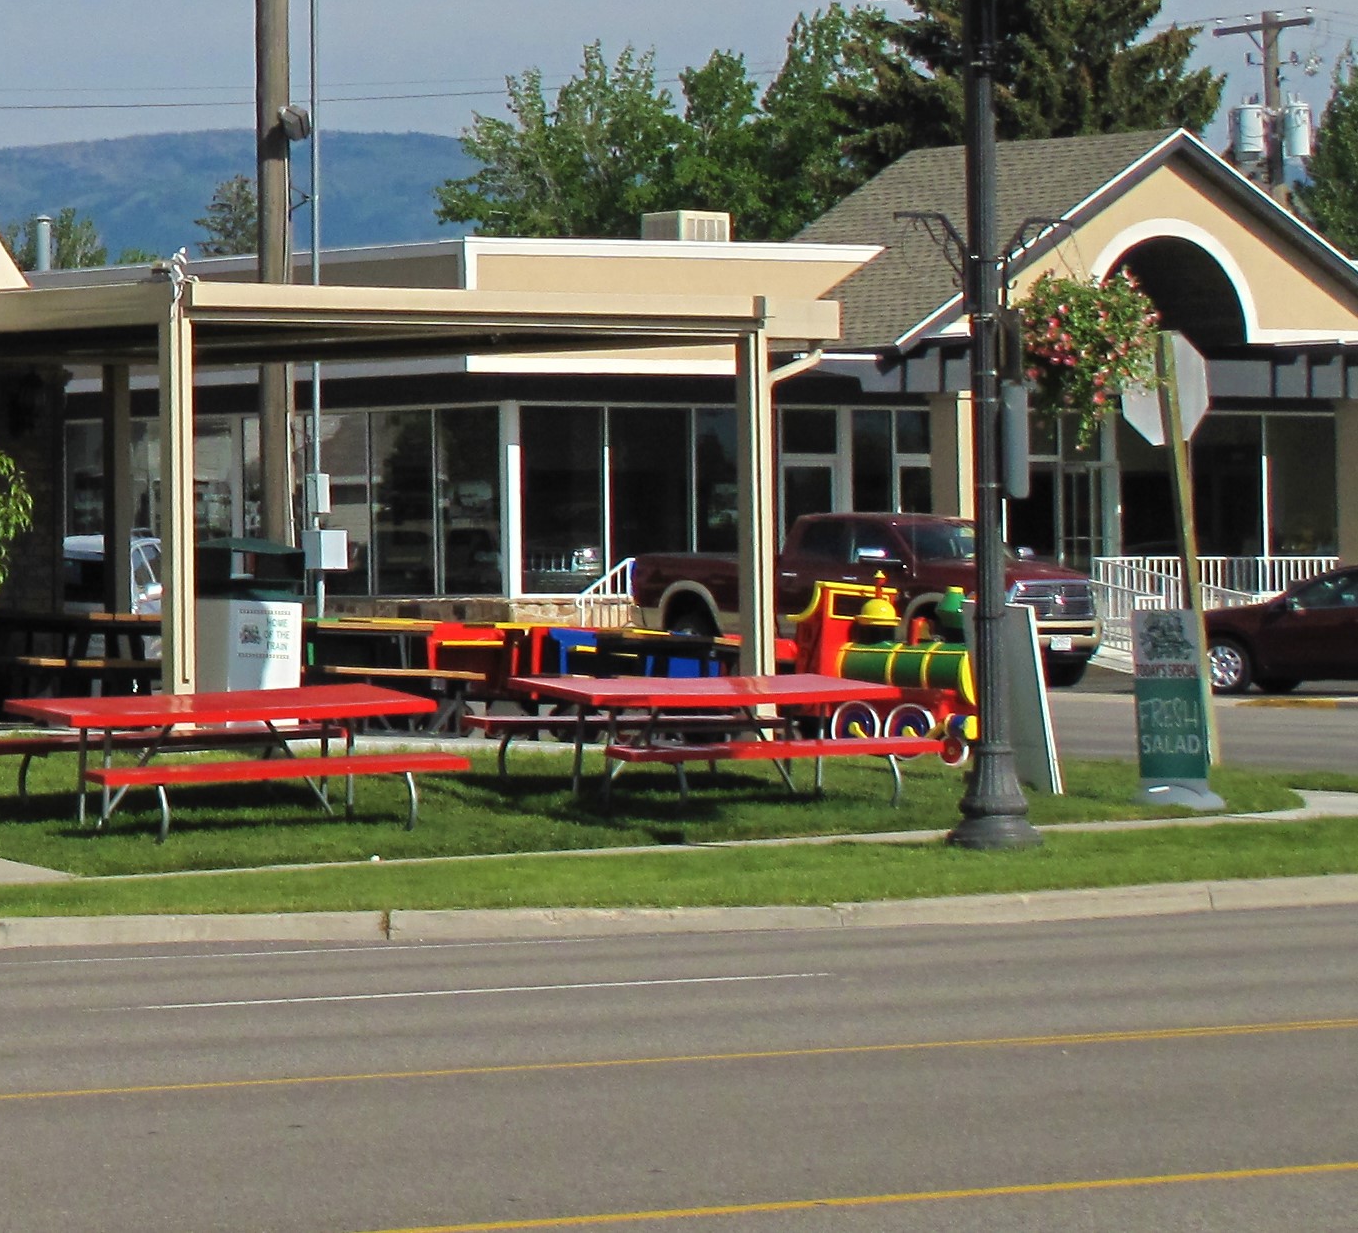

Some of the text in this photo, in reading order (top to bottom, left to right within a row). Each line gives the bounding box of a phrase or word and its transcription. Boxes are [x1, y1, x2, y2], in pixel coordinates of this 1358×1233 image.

[266, 618, 288, 627] HOME
[276, 630, 290, 639] THE
[266, 641, 288, 650] TRAIN
[1140, 697, 1198, 729] FRESH
[1141, 733, 1202, 754] SALAD
